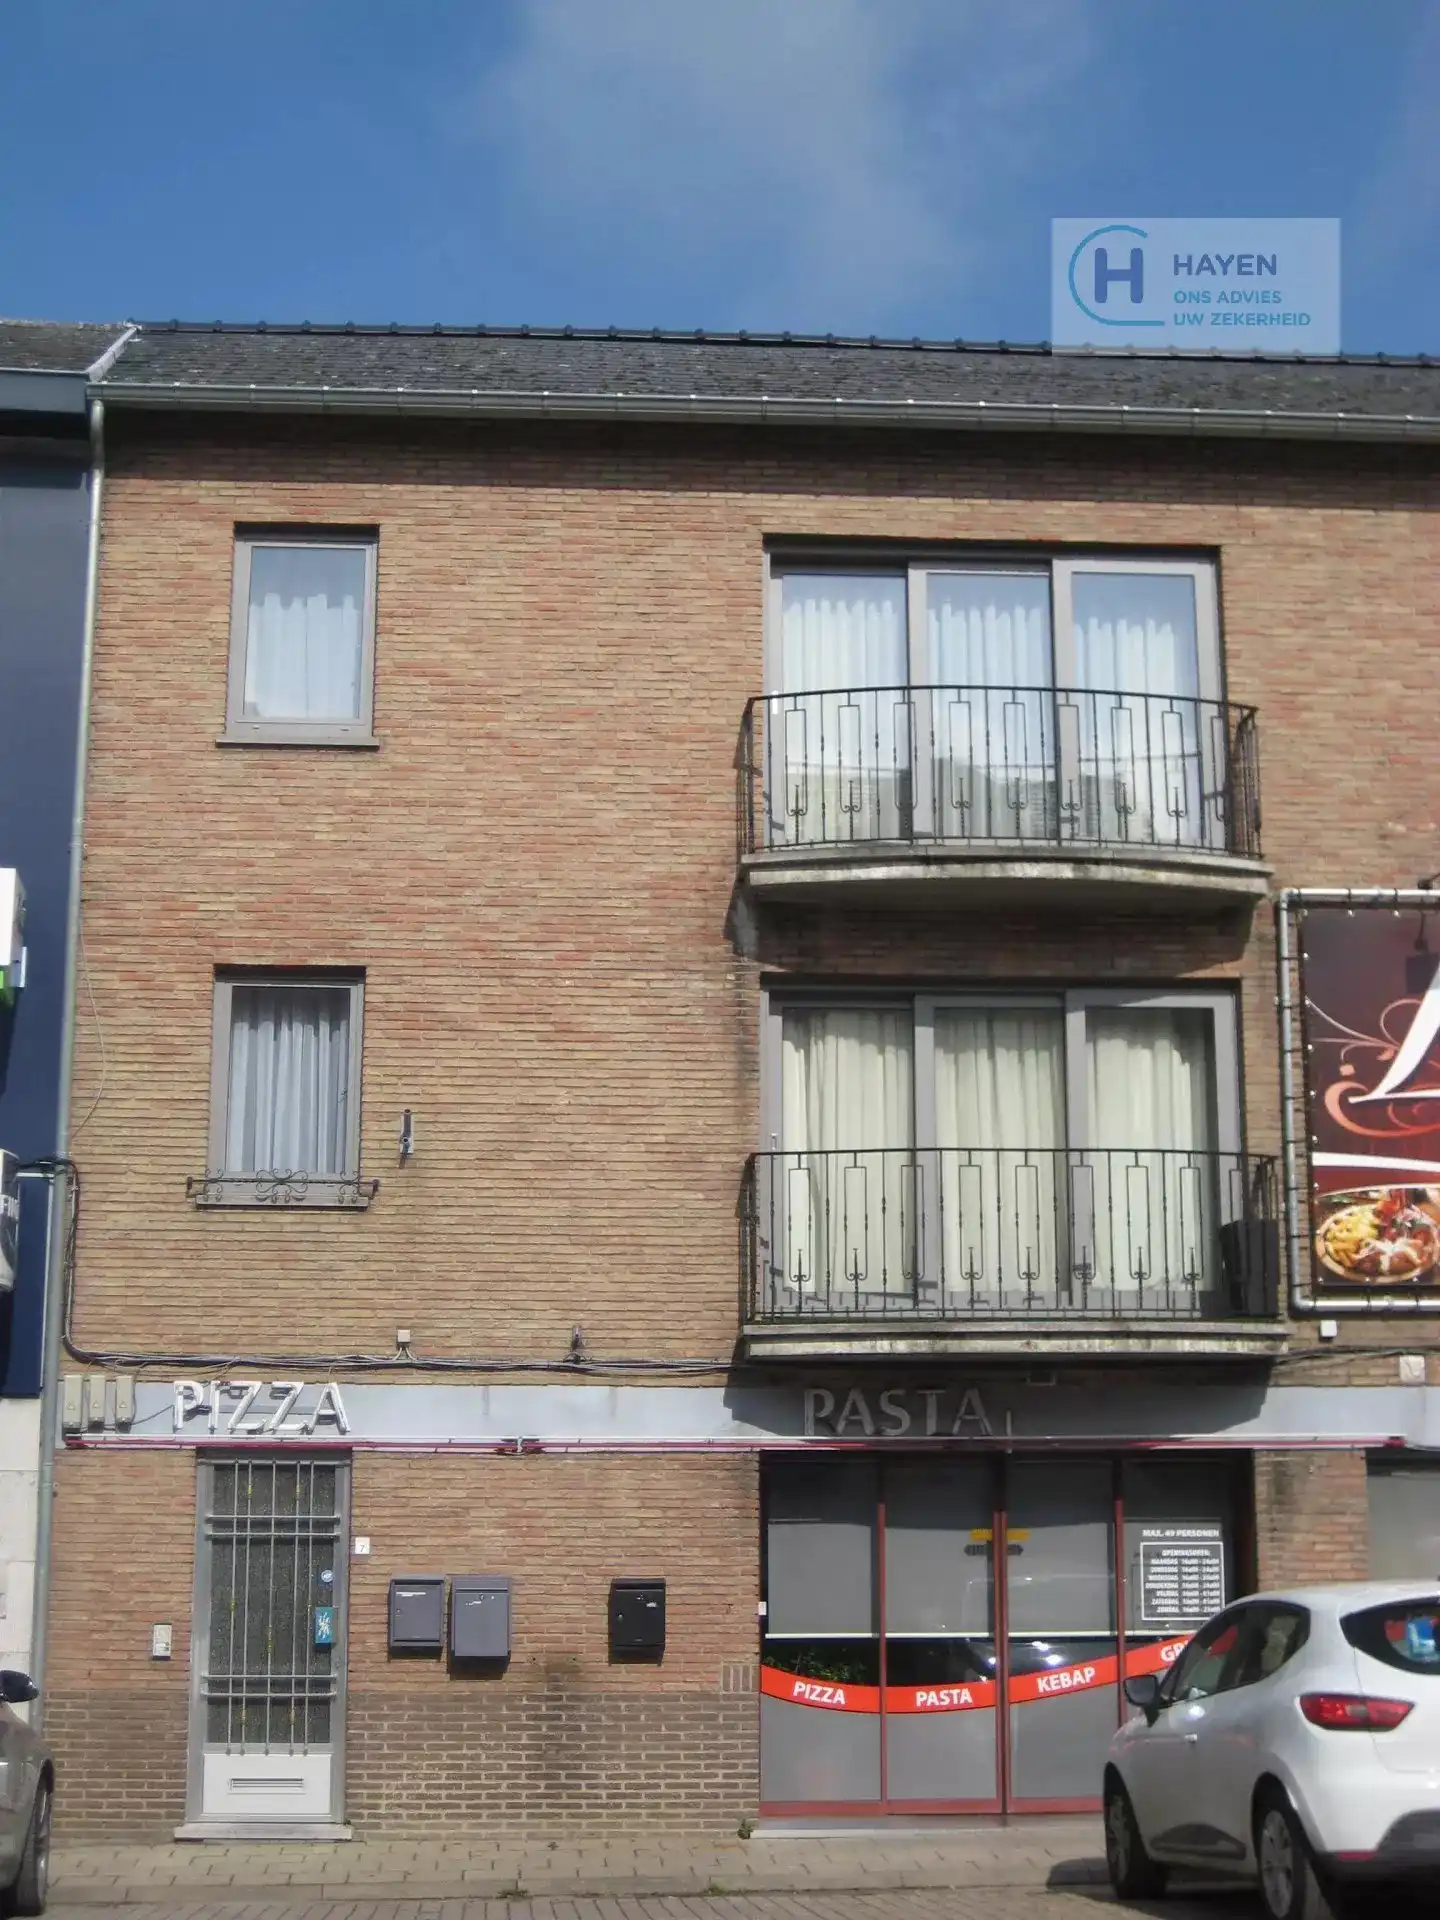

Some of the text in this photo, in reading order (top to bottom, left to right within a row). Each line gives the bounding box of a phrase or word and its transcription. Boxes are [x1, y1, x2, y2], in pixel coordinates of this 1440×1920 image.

[172, 1380, 351, 1435] PIZZA
[803, 1388, 994, 1437] PASTA
[793, 1681, 846, 1705] PIZZA
[915, 1688, 973, 1707] PASTA
[1036, 1666, 1096, 1693] KEBAP
